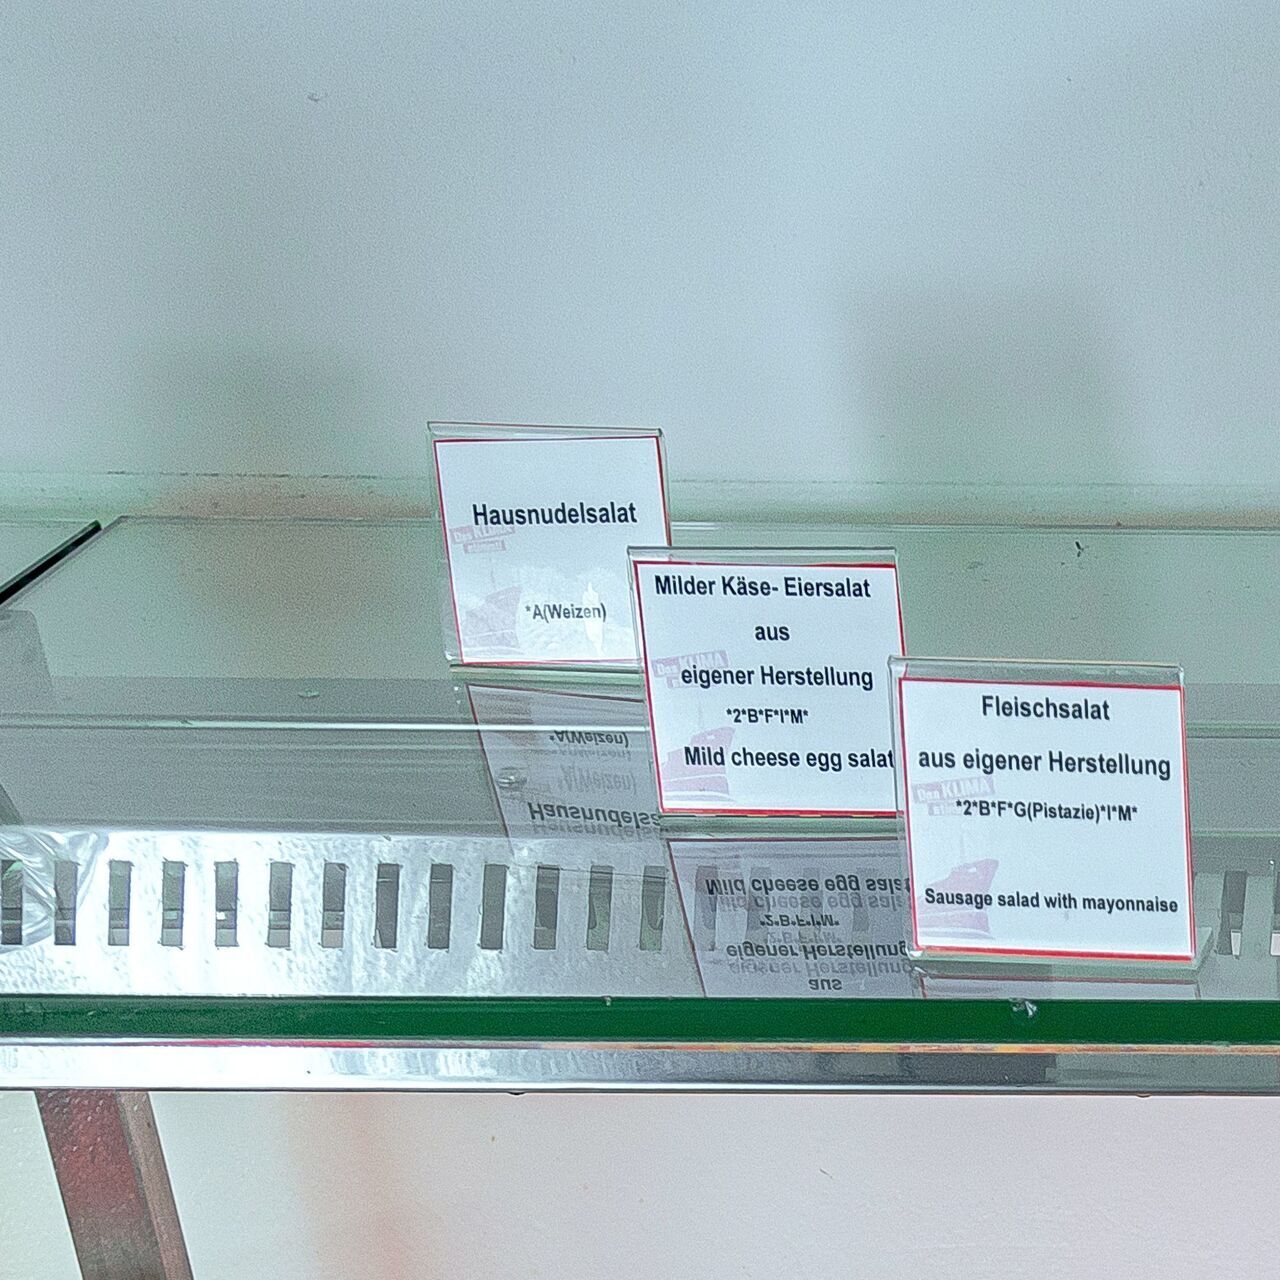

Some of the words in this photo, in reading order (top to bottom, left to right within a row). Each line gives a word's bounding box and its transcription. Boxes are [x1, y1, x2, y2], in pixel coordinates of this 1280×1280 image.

[473, 502, 637, 525] Hausnudelsalat
[655, 576, 715, 595] Milder
[722, 576, 778, 596] Käse-
[784, 577, 870, 597] Eiersalat
[755, 626, 789, 640] aus
[682, 665, 754, 689] eigener
[761, 666, 873, 691] Herstellung
[983, 696, 1109, 720] Fleischsalat
[684, 747, 724, 766] Mild
[731, 748, 800, 766] cheese
[806, 752, 842, 772] egg
[848, 749, 894, 768] salat
[919, 752, 955, 768] aus
[963, 748, 1042, 775] eigener
[1049, 751, 1170, 780] Herstellung
[941, 778, 990, 797] KLIMA
[926, 888, 992, 909] Sausage
[998, 892, 1039, 907] salad
[1044, 893, 1077, 909] with
[1083, 896, 1177, 914] mayonnaise
